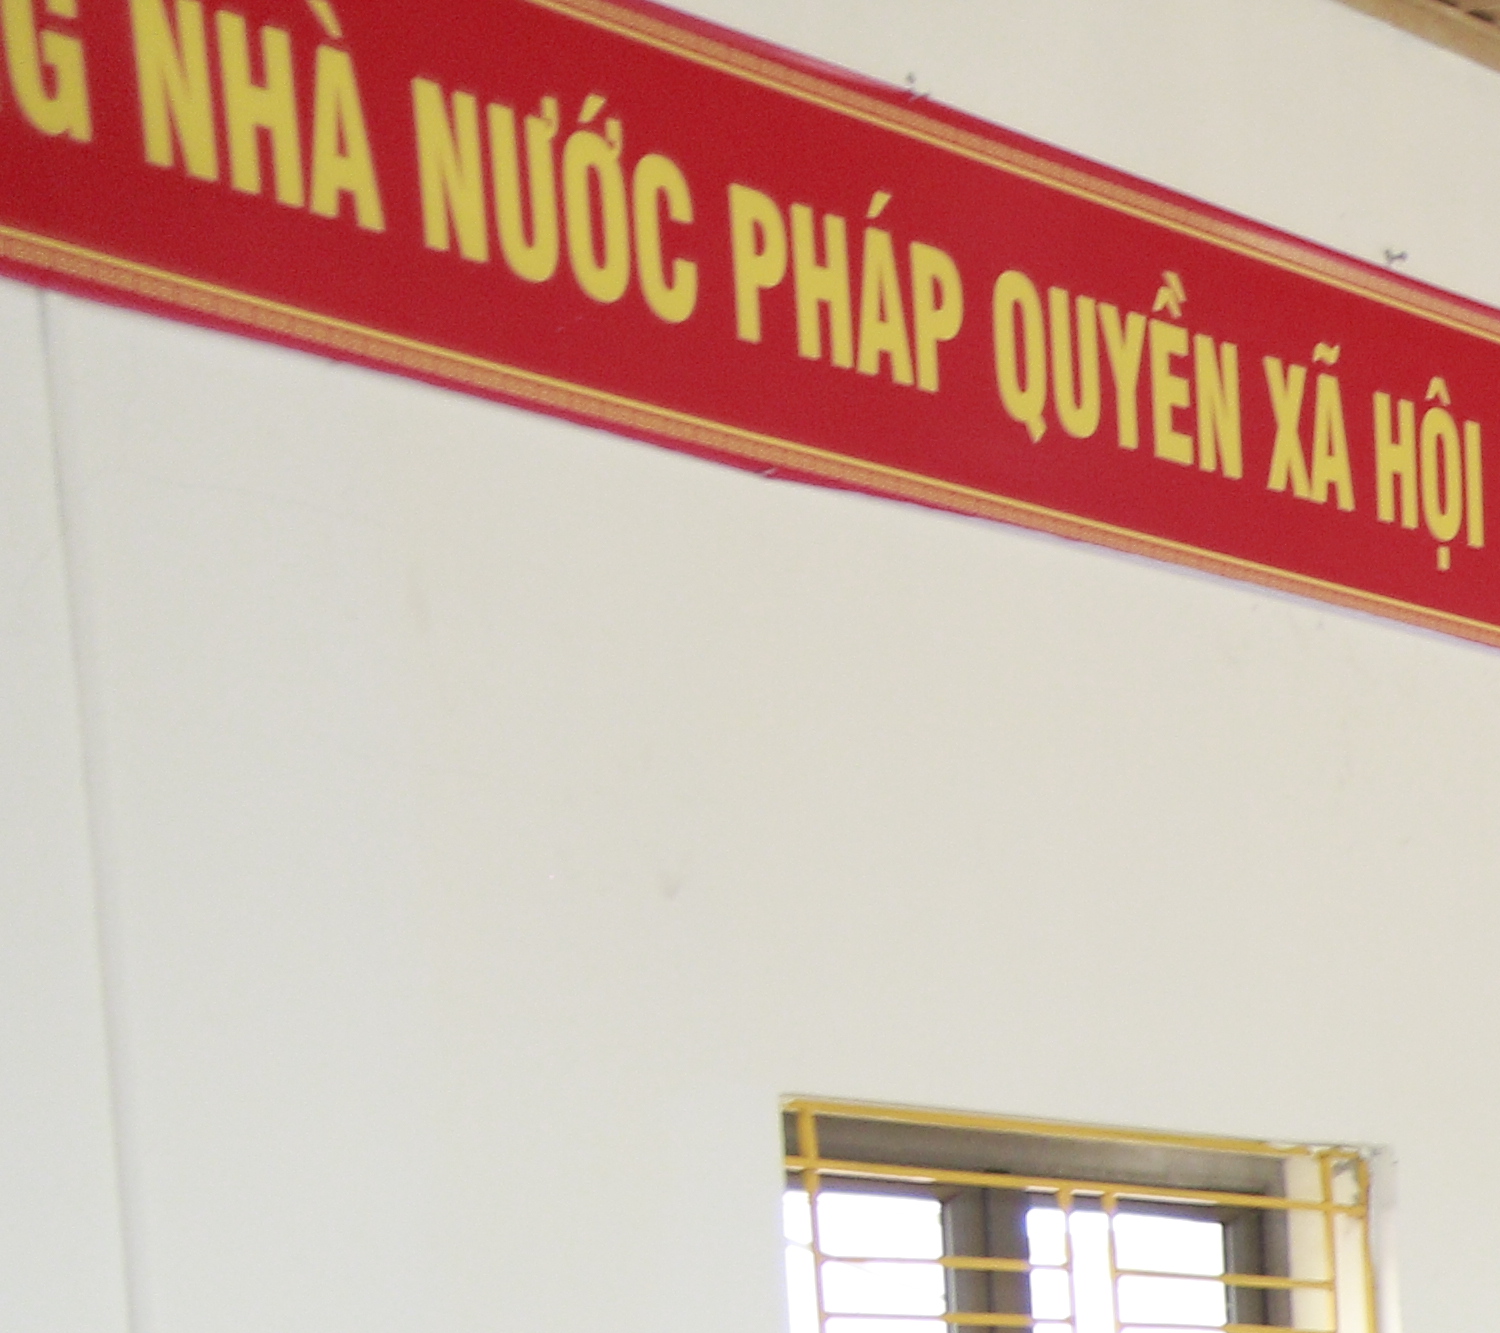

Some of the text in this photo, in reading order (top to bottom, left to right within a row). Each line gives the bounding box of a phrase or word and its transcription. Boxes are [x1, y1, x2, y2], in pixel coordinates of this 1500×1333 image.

[129, 0, 384, 232] NHÀ
[412, 78, 698, 323] NƯỚC
[729, 183, 964, 392] PHÁP
[993, 270, 1243, 480] QUYỀN
[1264, 342, 1355, 511] XÃ
[1373, 377, 1485, 570] HỘI
